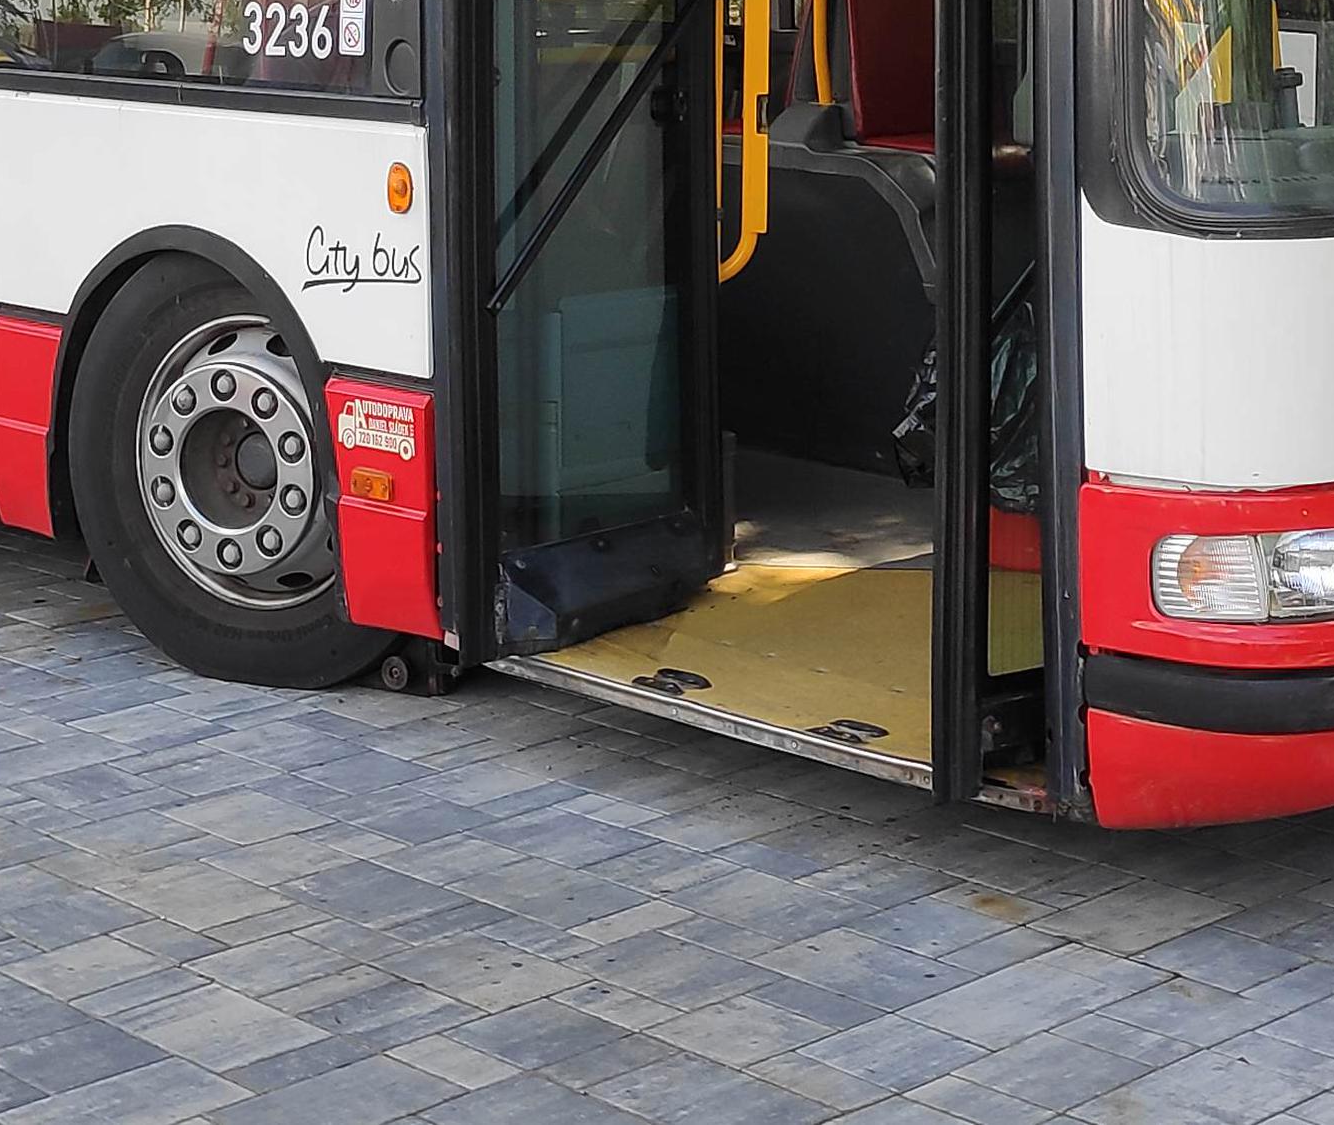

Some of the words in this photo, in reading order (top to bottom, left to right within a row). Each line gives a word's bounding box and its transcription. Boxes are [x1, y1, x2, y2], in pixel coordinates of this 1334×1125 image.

[242, 1, 333, 60] 3236
[305, 225, 361, 293] City
[372, 232, 423, 283] bus
[355, 399, 415, 430] AUTODOPRAVA
